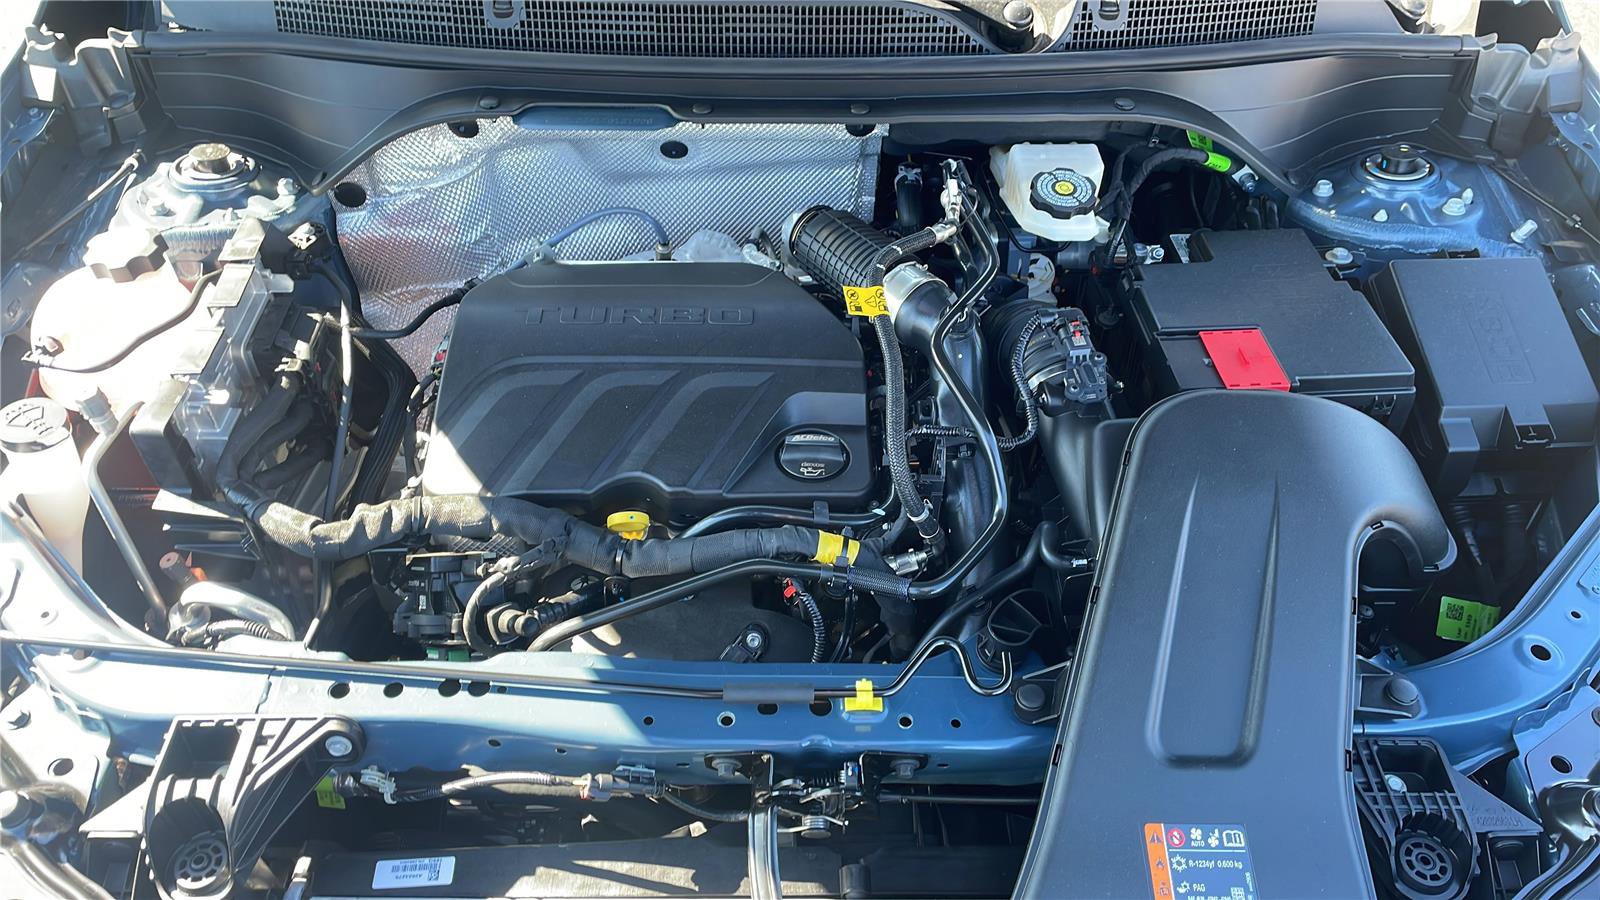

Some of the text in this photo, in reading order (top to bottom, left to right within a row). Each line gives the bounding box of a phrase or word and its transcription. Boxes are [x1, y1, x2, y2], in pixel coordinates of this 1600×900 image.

[514, 305, 755, 326] TURBO
[1234, 860, 1243, 869] kg
[1192, 883, 1206, 892] PAG
